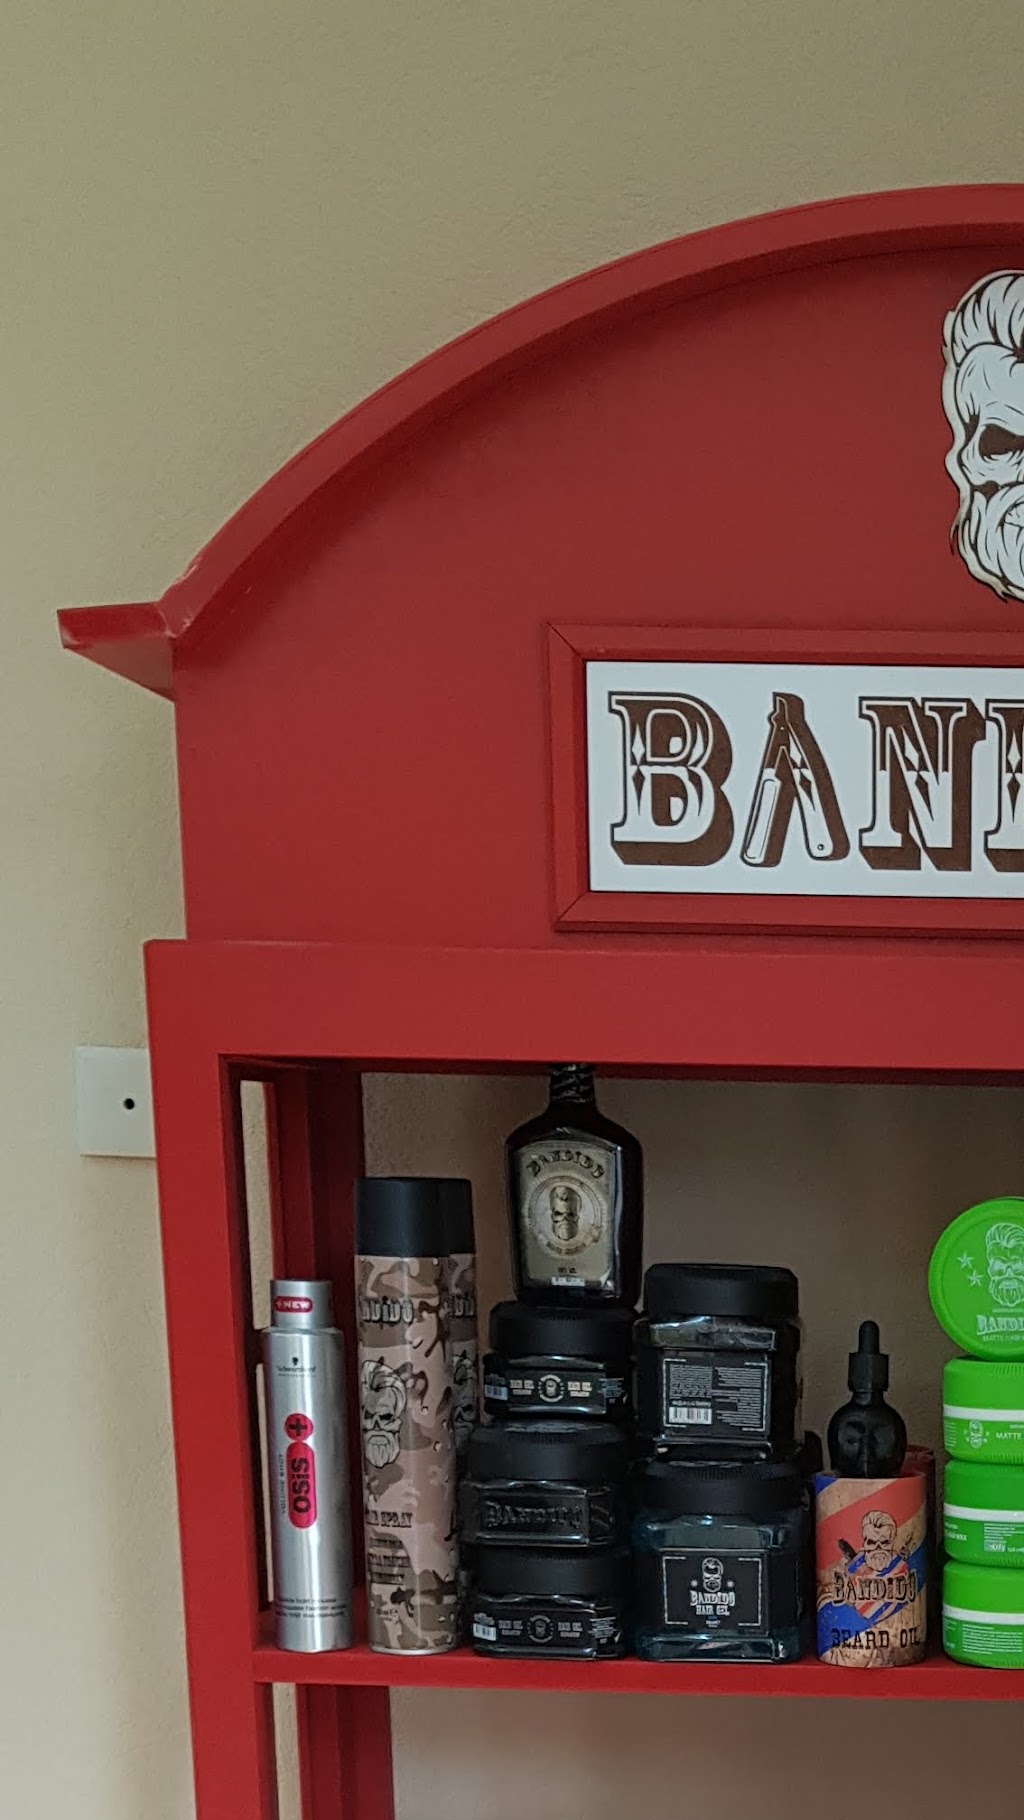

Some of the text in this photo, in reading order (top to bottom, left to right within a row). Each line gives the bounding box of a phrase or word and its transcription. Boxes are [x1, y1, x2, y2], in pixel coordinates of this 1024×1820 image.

[996, 1431, 1022, 1441] MATTE
[832, 1629, 920, 1649] BEARD OIL
